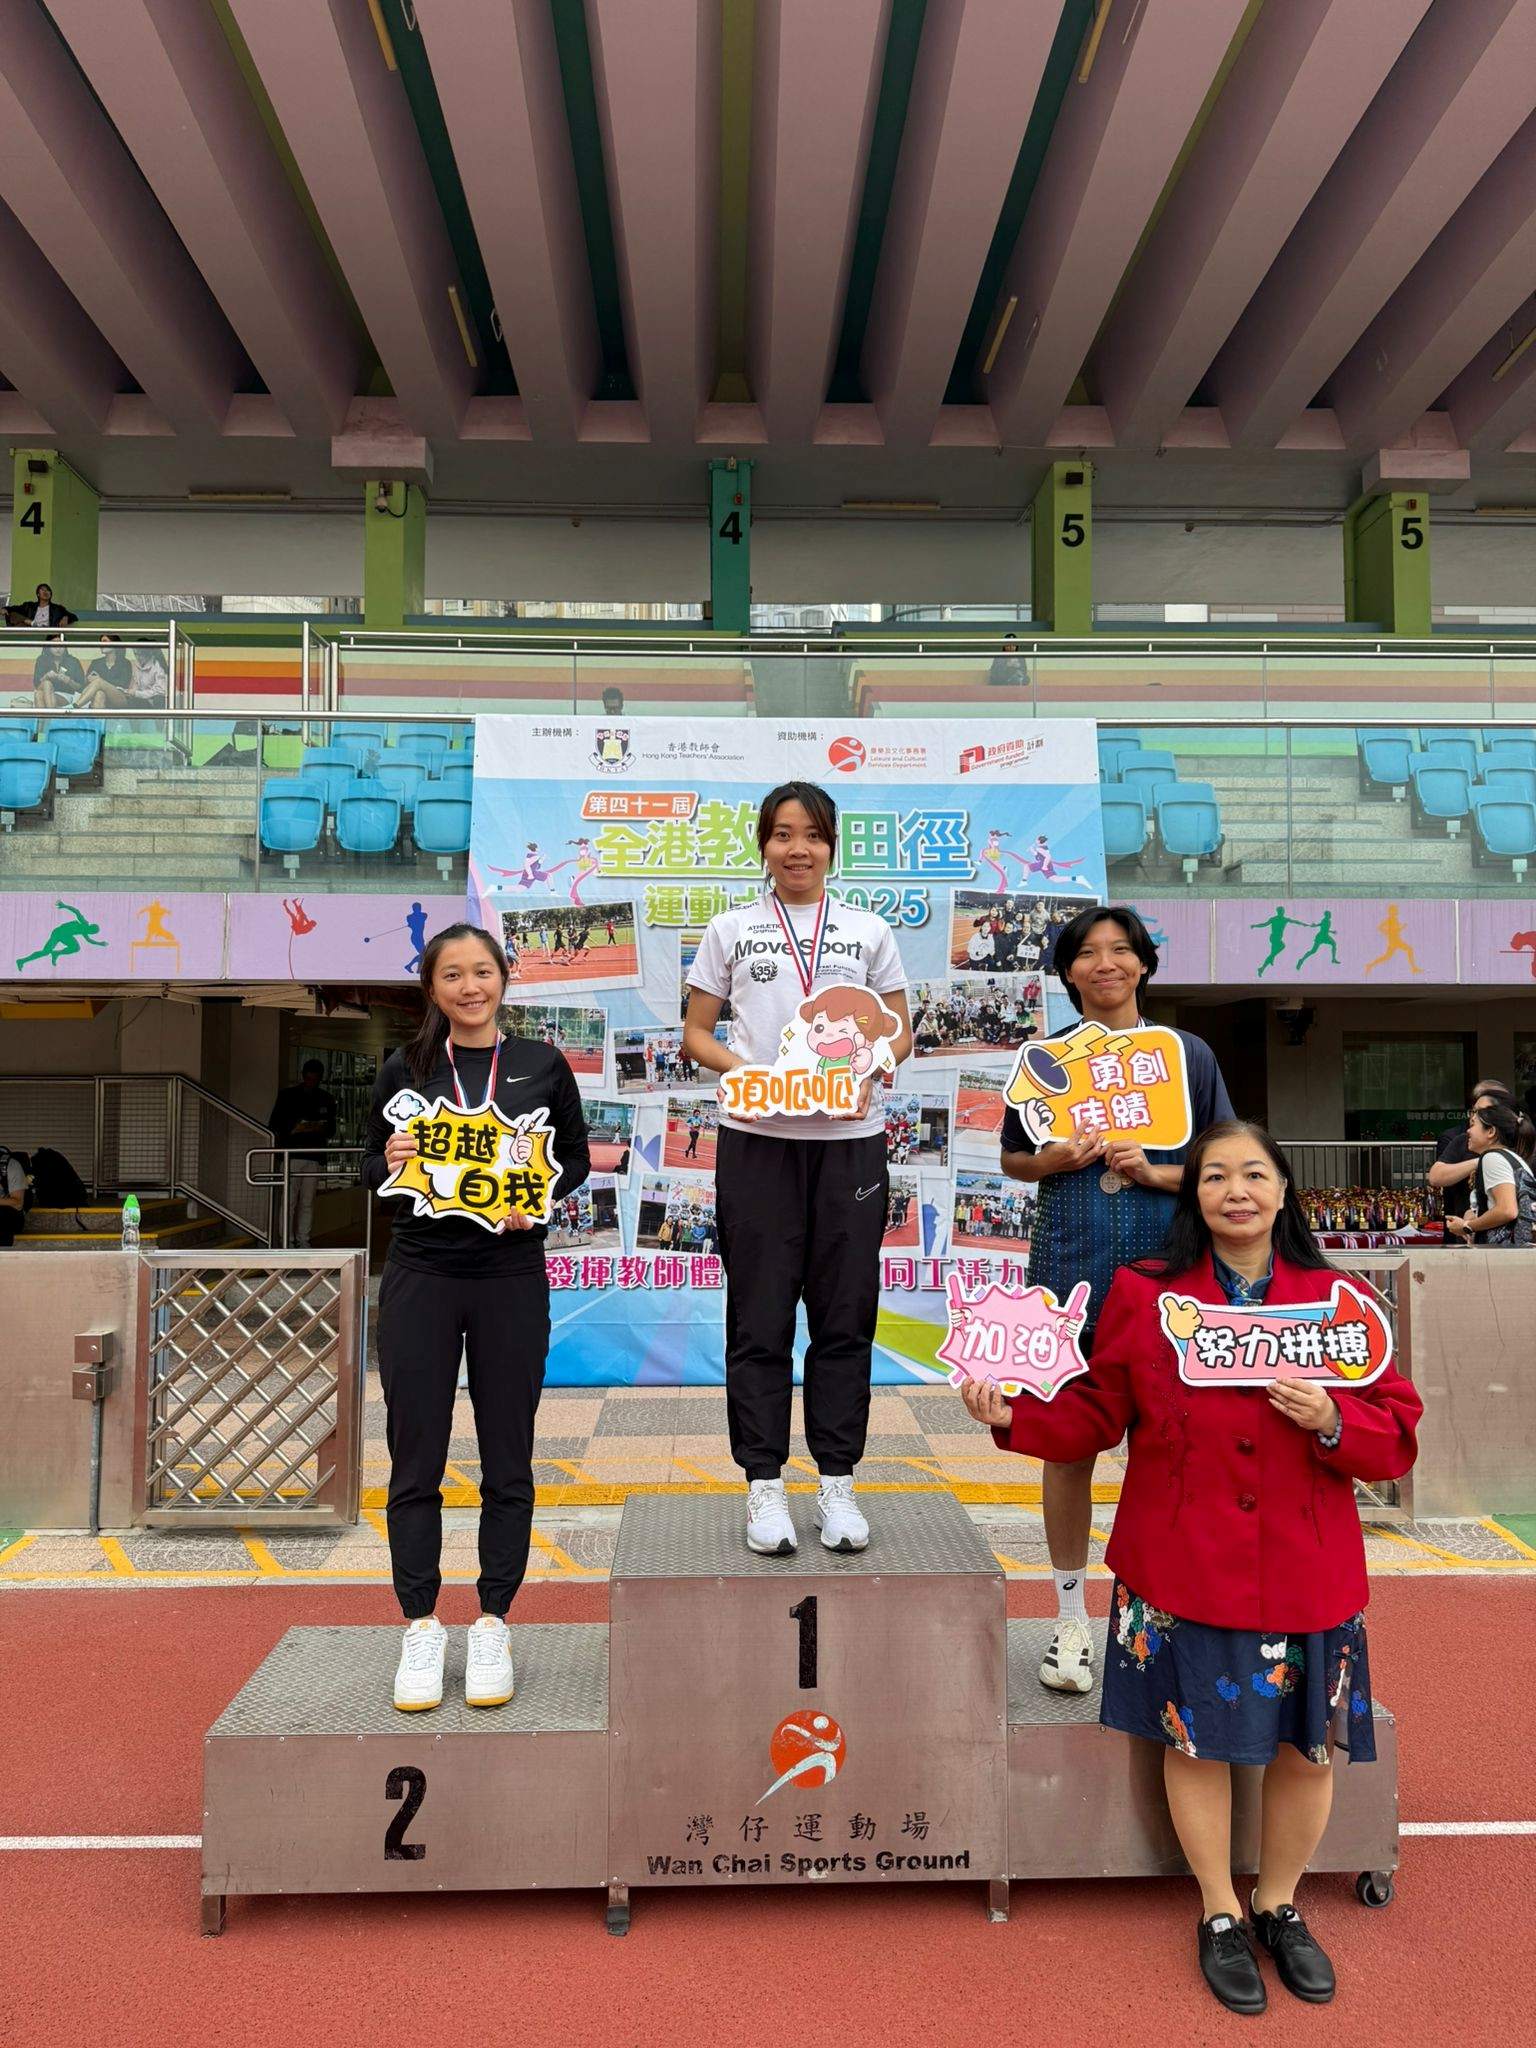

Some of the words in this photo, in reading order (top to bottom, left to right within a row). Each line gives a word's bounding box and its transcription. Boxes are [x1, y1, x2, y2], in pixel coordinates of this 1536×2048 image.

[20, 502, 44, 535] 4
[719, 511, 743, 545] 4
[1061, 513, 1085, 547] 5
[1401, 517, 1424, 549] 5
[660, 752, 678, 760] Kong
[709, 753, 745, 761] Association
[588, 796, 692, 816] 第四十一屆
[756, 965, 771, 976] 35
[1088, 1048, 1170, 1091] 勇創
[725, 1067, 854, 1112] 頂呱呱
[1069, 1090, 1153, 1133] 佳績
[412, 1120, 499, 1164] 超越
[459, 1167, 546, 1212] 自我
[963, 1316, 1060, 1369] 加油
[1195, 1321, 1371, 1368] 努力拼搏
[789, 1596, 818, 1689] 1
[384, 1765, 428, 1860] 2
[686, 1812, 931, 1846] 灣仔運動場
[647, 1855, 703, 1875] Wan
[712, 1853, 771, 1874] Chai
[780, 1851, 867, 1877] Sports
[875, 1849, 970, 1872] Ground
